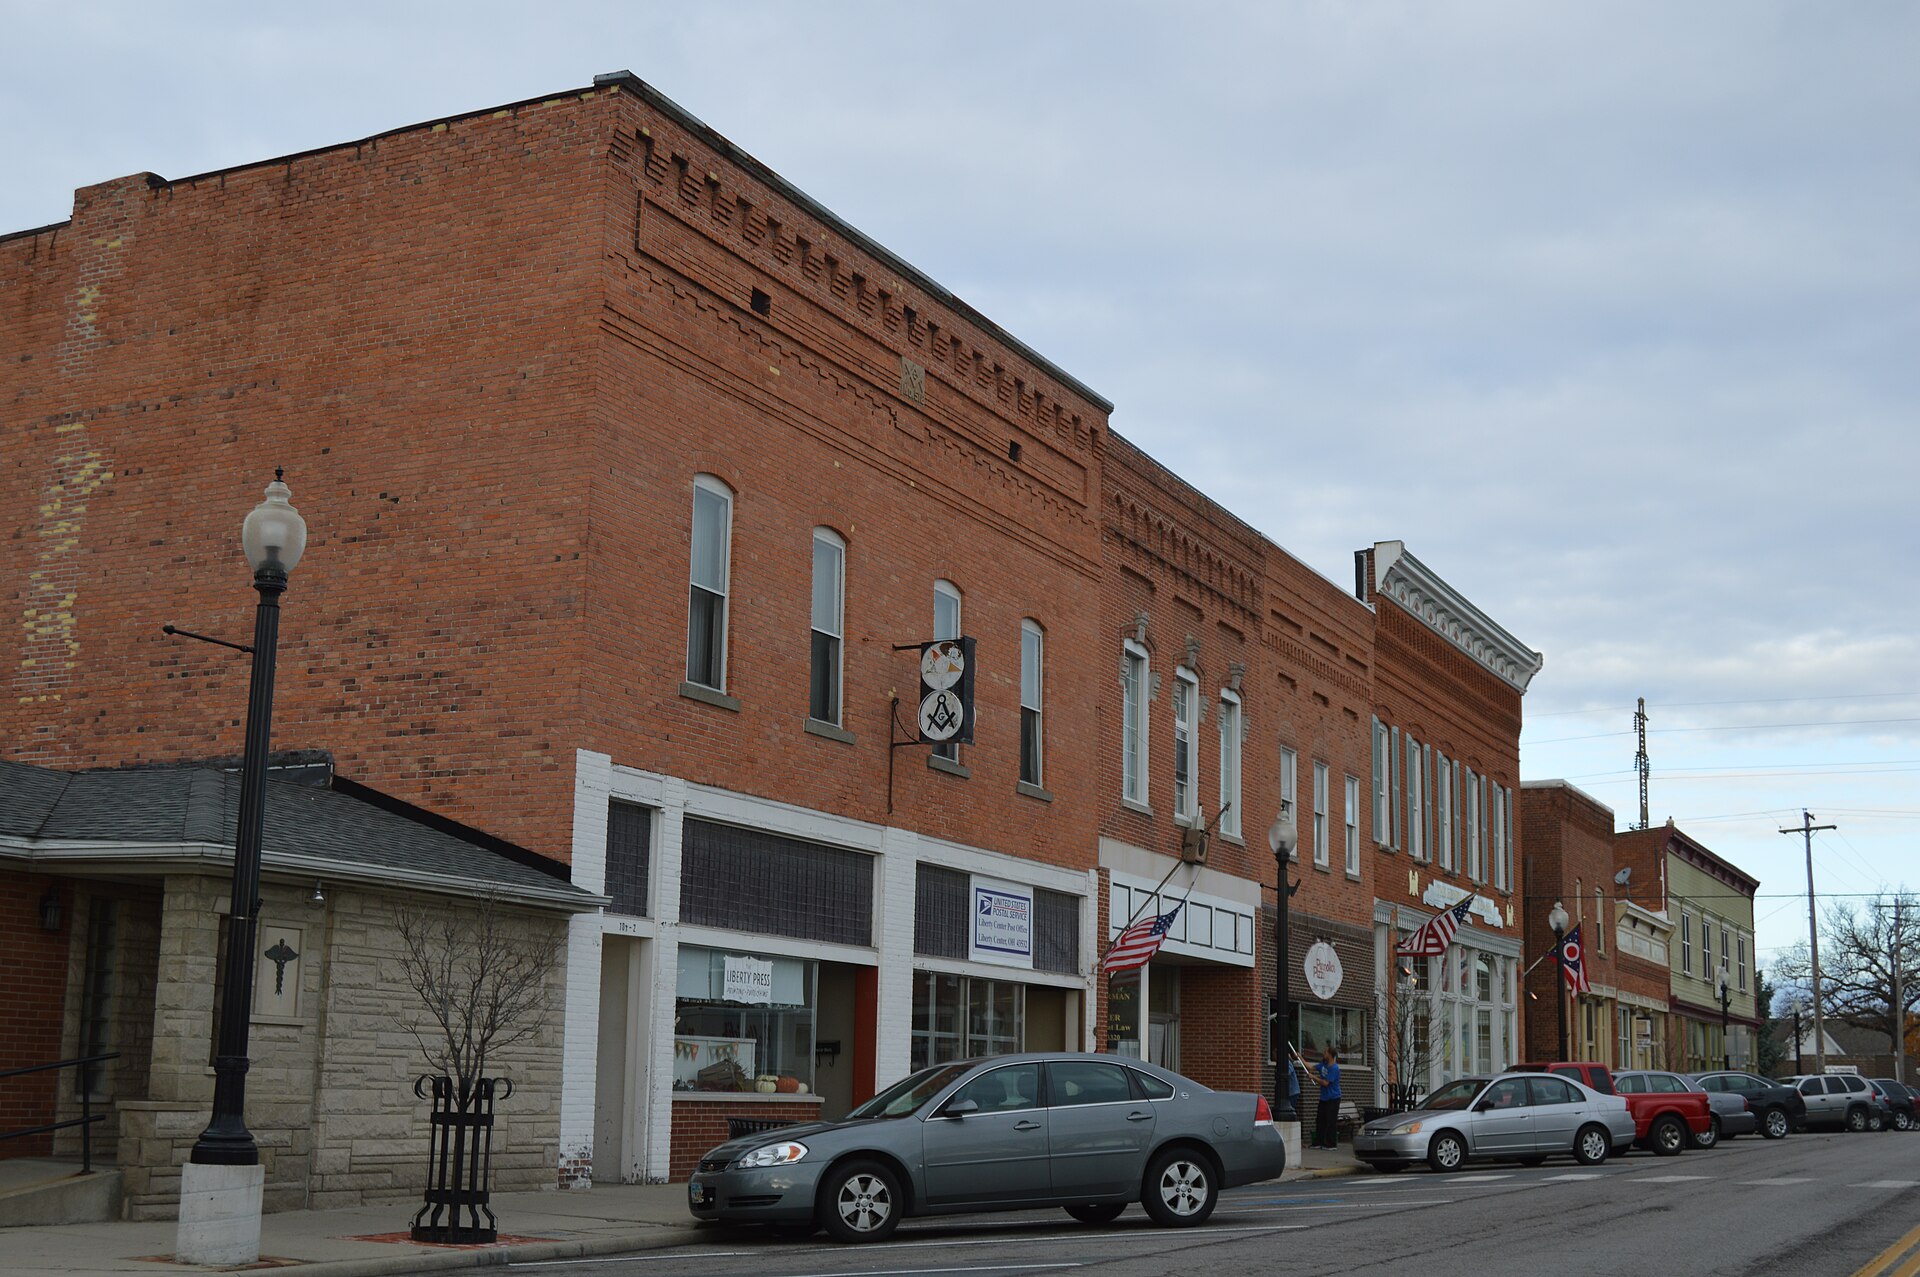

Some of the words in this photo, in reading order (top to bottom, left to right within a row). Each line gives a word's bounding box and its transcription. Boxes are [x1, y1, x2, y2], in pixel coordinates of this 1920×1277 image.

[938, 712, 945, 721] G
[993, 897, 1012, 908] UNITED
[1011, 900, 1027, 911] STATES
[992, 908, 1010, 919] POSTAL
[1009, 910, 1027, 921] SERVICE
[978, 918, 993, 930] Liberty
[993, 919, 1007, 930] Center
[1007, 922, 1016, 932] Post
[1016, 924, 1028, 934] Office
[978, 933, 993, 945] Liberty
[726, 970, 752, 984] LIBERTY
[752, 972, 771, 987] PRESS
